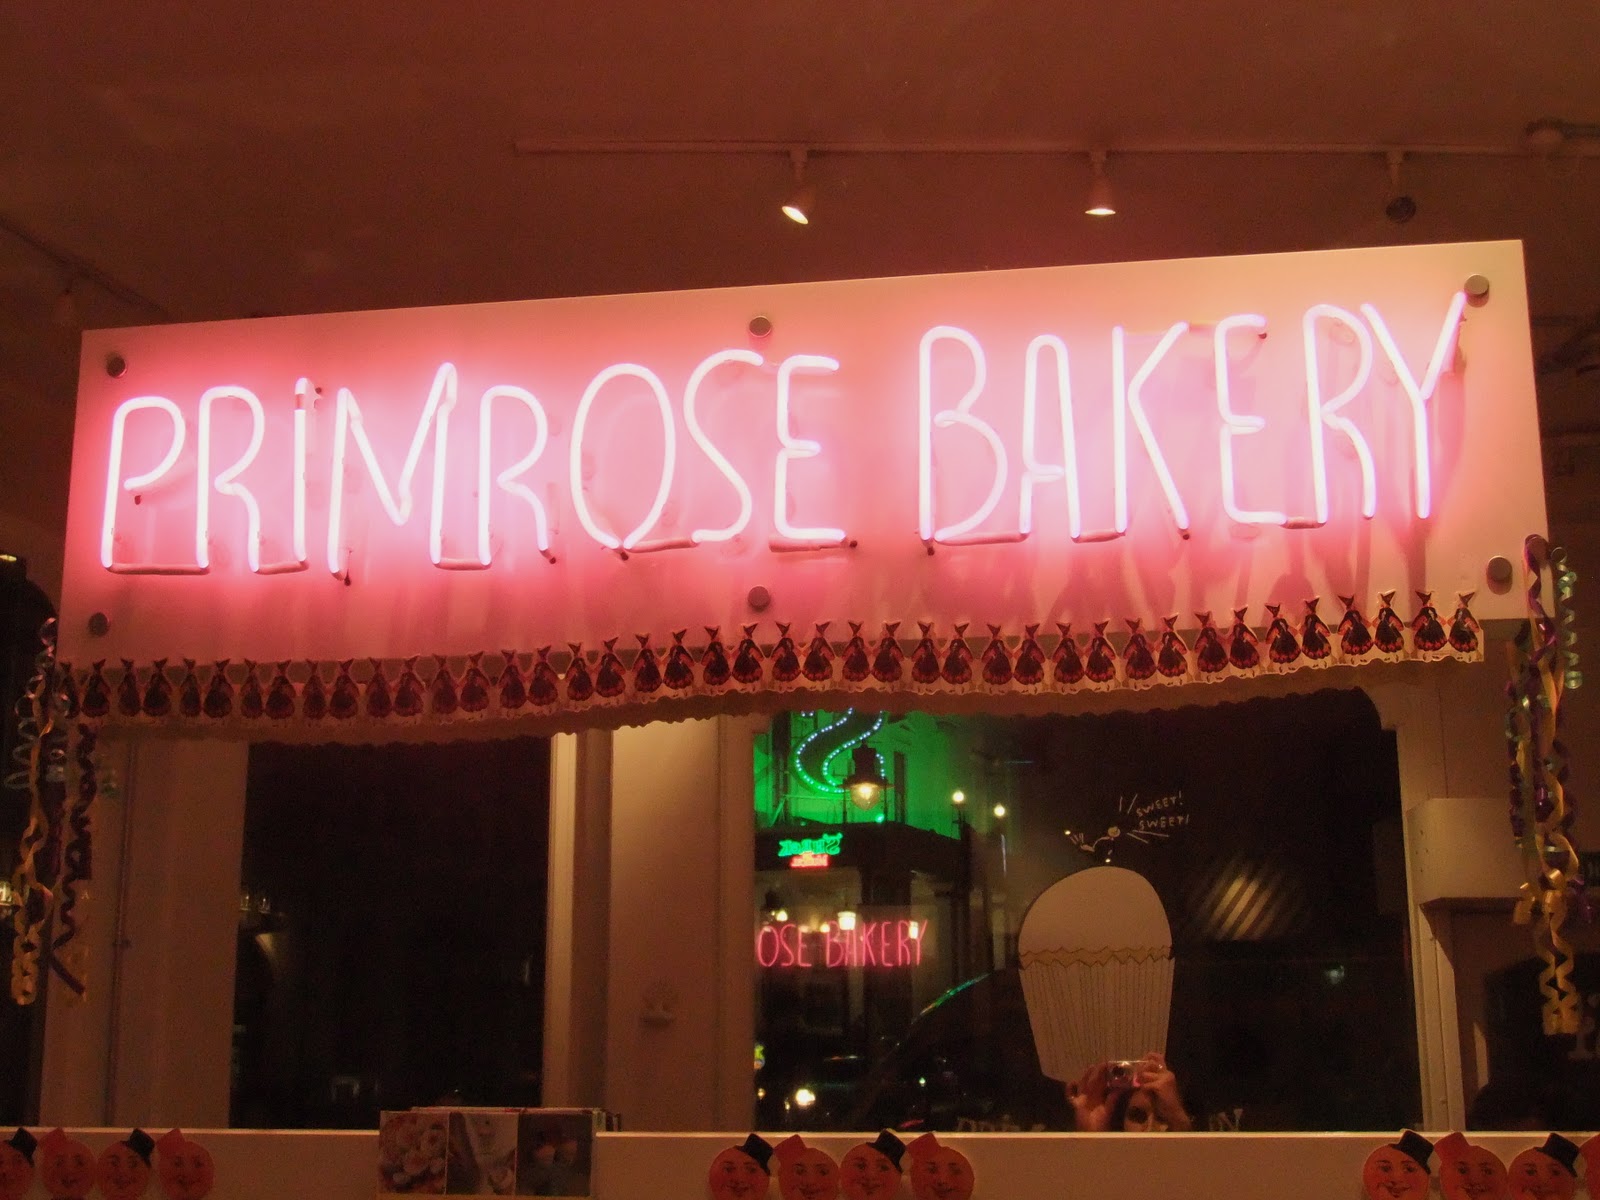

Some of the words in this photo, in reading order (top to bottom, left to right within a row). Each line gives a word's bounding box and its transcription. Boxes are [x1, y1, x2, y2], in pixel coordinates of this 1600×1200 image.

[917, 292, 1467, 542] BAKERY
[1136, 790, 1183, 818] SWEET!
[1138, 814, 1190, 831] SWEET!
[757, 923, 812, 967] OSE
[826, 919, 928, 967] BAKERY
